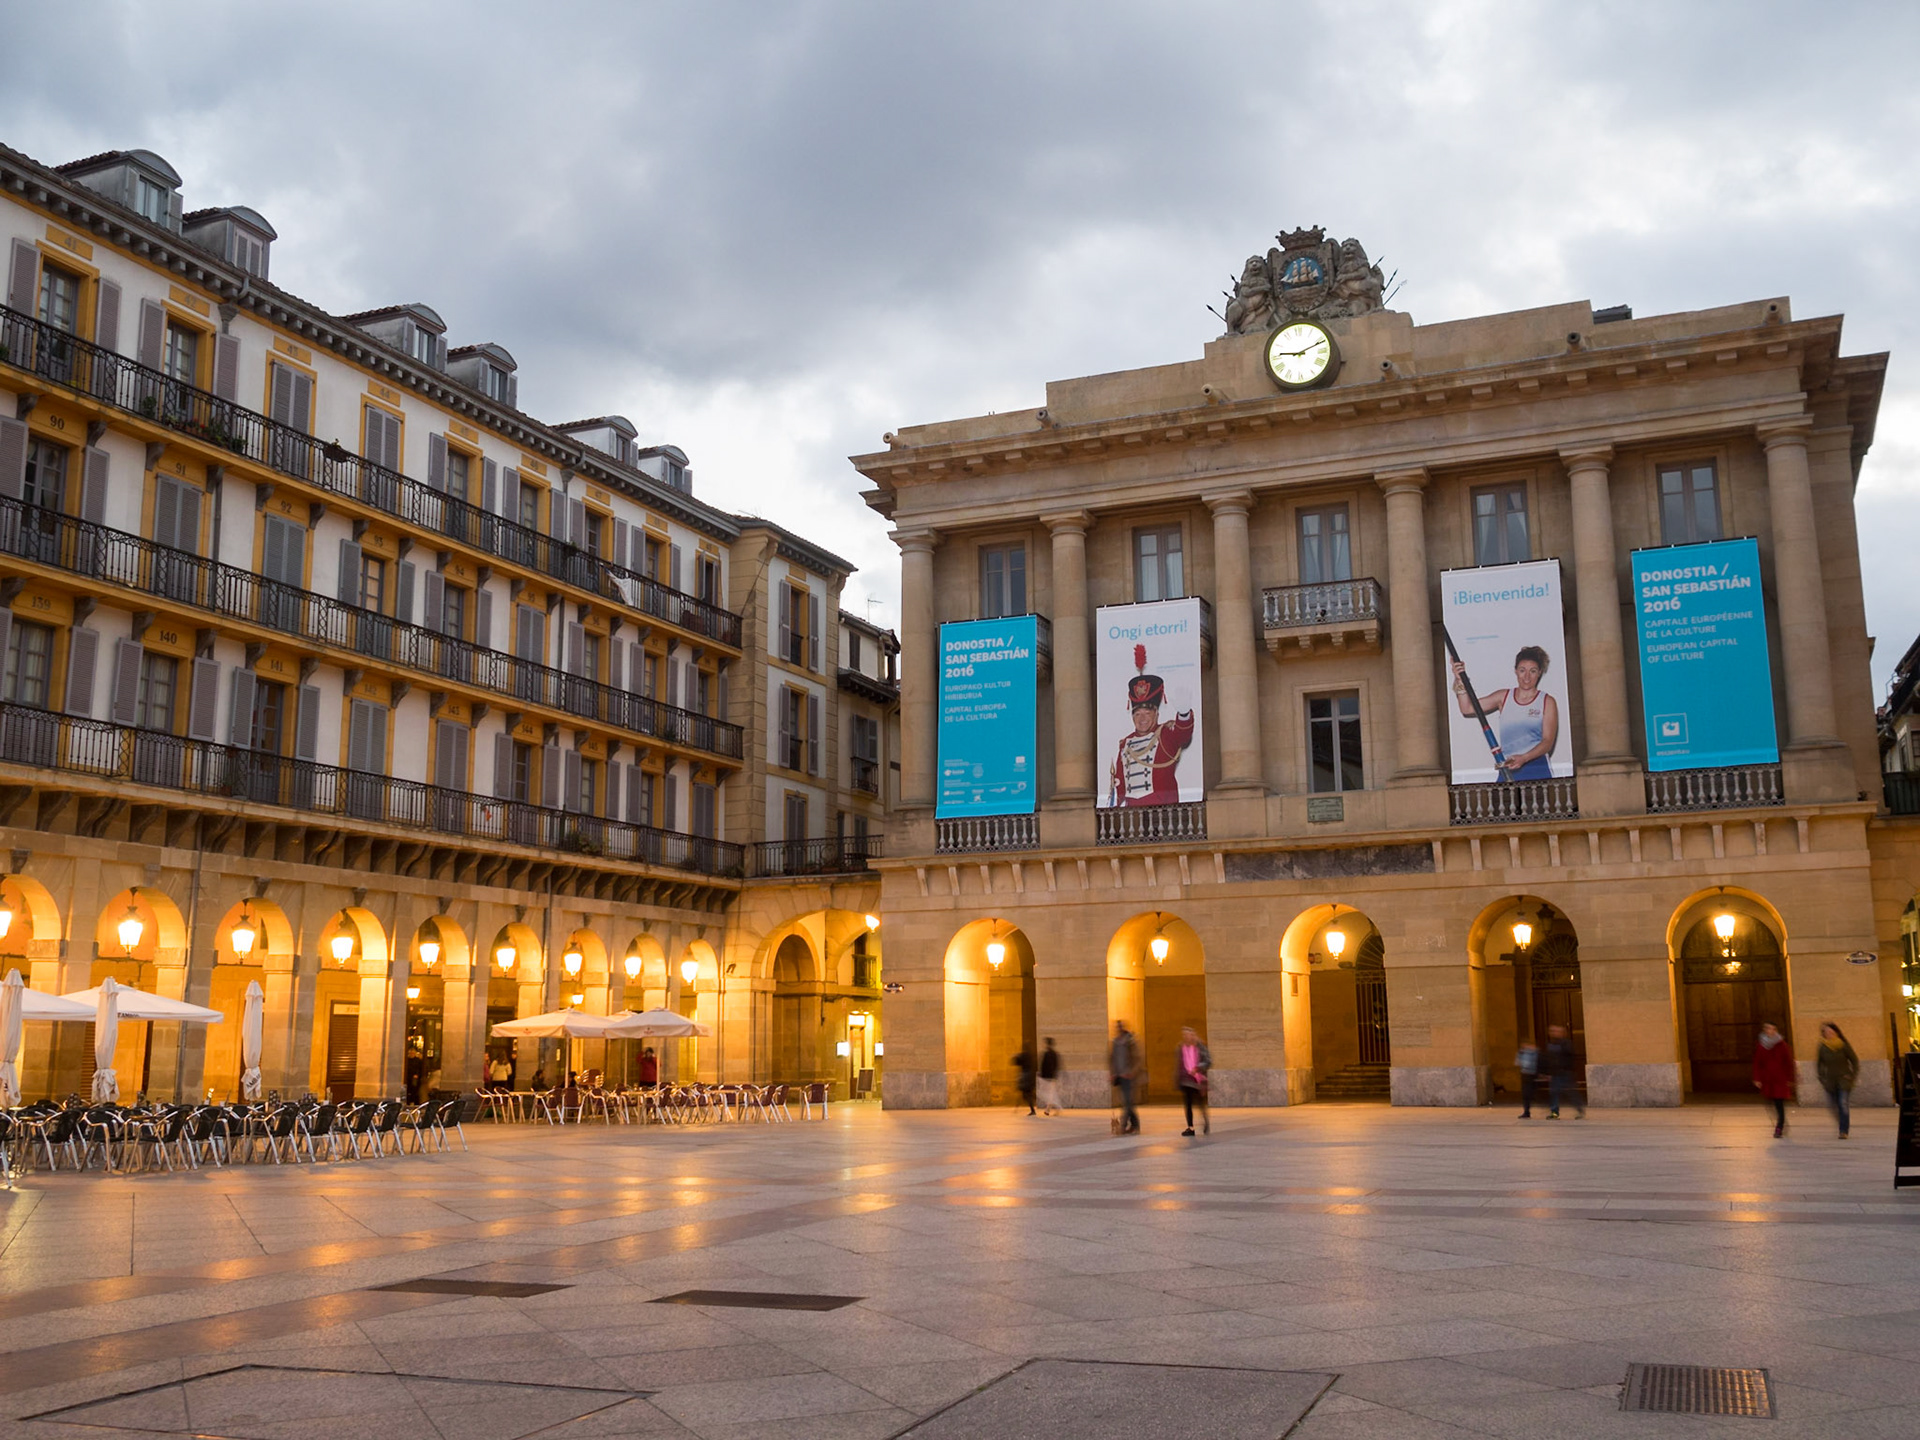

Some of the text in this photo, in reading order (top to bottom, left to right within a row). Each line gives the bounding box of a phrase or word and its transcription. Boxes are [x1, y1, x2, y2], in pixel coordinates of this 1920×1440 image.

[64, 237, 77, 251] 41
[50, 415, 65, 430] 90
[176, 462, 187, 476] 91
[280, 500, 292, 514] 92
[1640, 565, 1717, 583] DONOSTIA
[1453, 582, 1550, 605] ¡Bienvenida!
[1642, 574, 1752, 598] SAN SEBASTIÁN
[32, 596, 52, 610] 139
[1643, 596, 1681, 613] 2016
[1644, 611, 1754, 629] CAPITALE EUROPÉENNE
[160, 630, 178, 645] 140
[1108, 619, 1188, 641] Ongi etorri!
[1645, 624, 1717, 639] DE LA CULTURE
[945, 637, 1005, 652] DONOSTIA
[1647, 637, 1738, 653] EUROPEAN CAPITAL
[945, 646, 1029, 665] SAN SEBASTIÁN
[1647, 651, 1704, 664] OF CULTURE
[270, 660, 284, 673] 141
[945, 664, 975, 678] 2016
[945, 680, 1011, 692] EUROPAKO KULTUR
[944, 703, 1007, 714] CAPITAL EUROPEA
[944, 712, 998, 723] DE LA CULTURA
